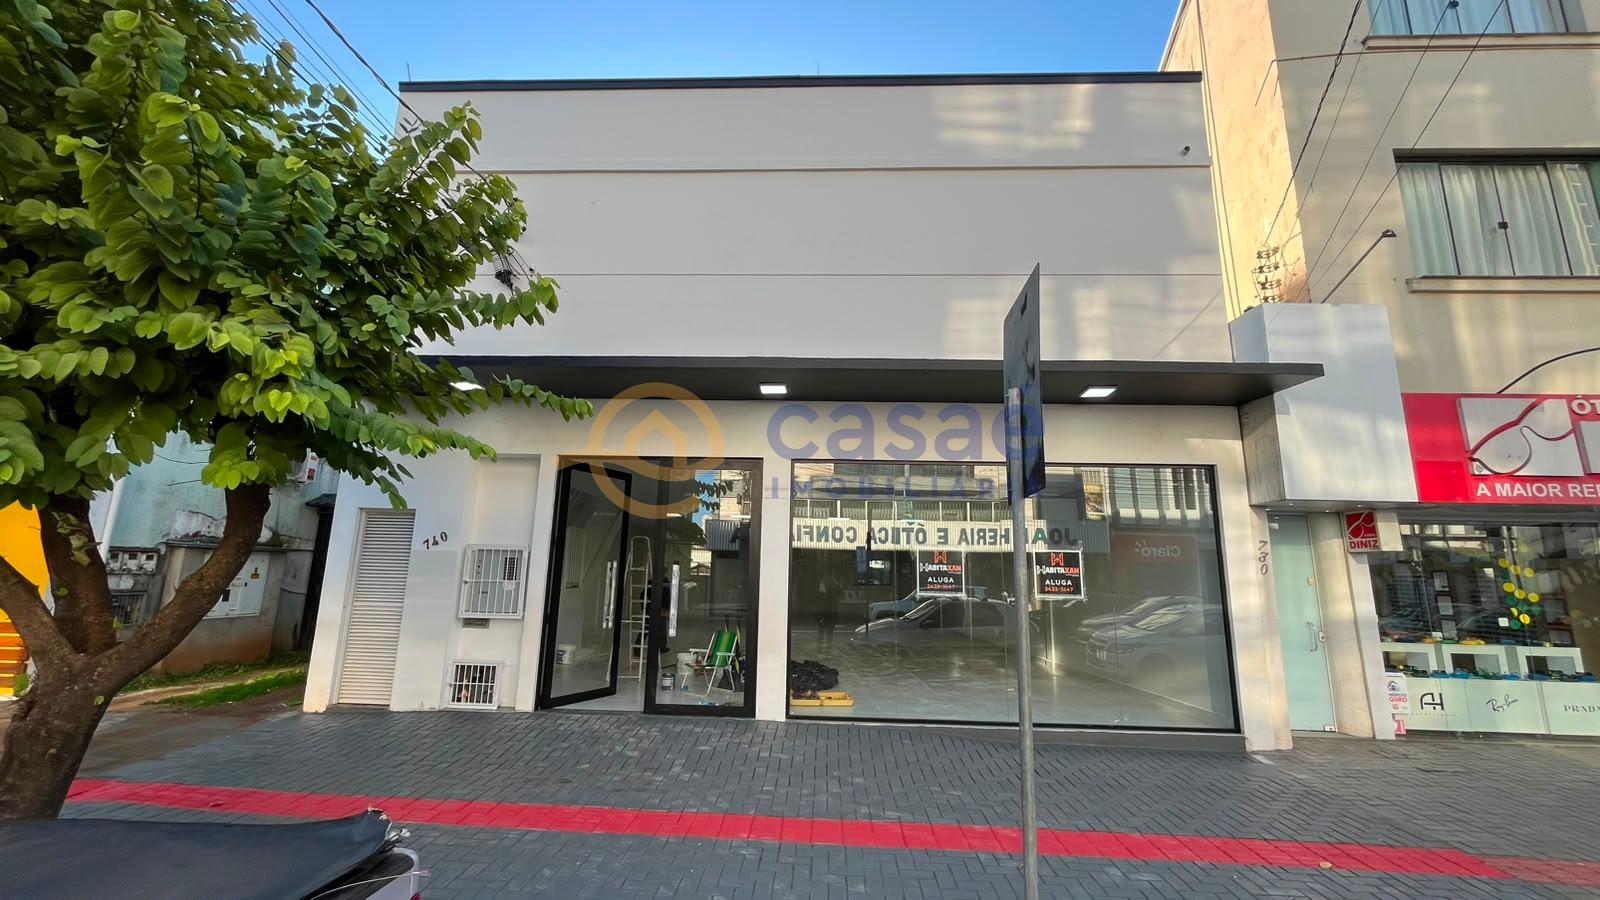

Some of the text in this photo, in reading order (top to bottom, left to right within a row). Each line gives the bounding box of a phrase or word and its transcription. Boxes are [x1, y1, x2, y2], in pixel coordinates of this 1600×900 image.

[1476, 483, 1491, 497] A
[1495, 483, 1563, 497] MAIOR
[422, 531, 448, 550] 740
[1349, 539, 1379, 549] DINIZ
[1036, 565, 1080, 575] HABITAXAN
